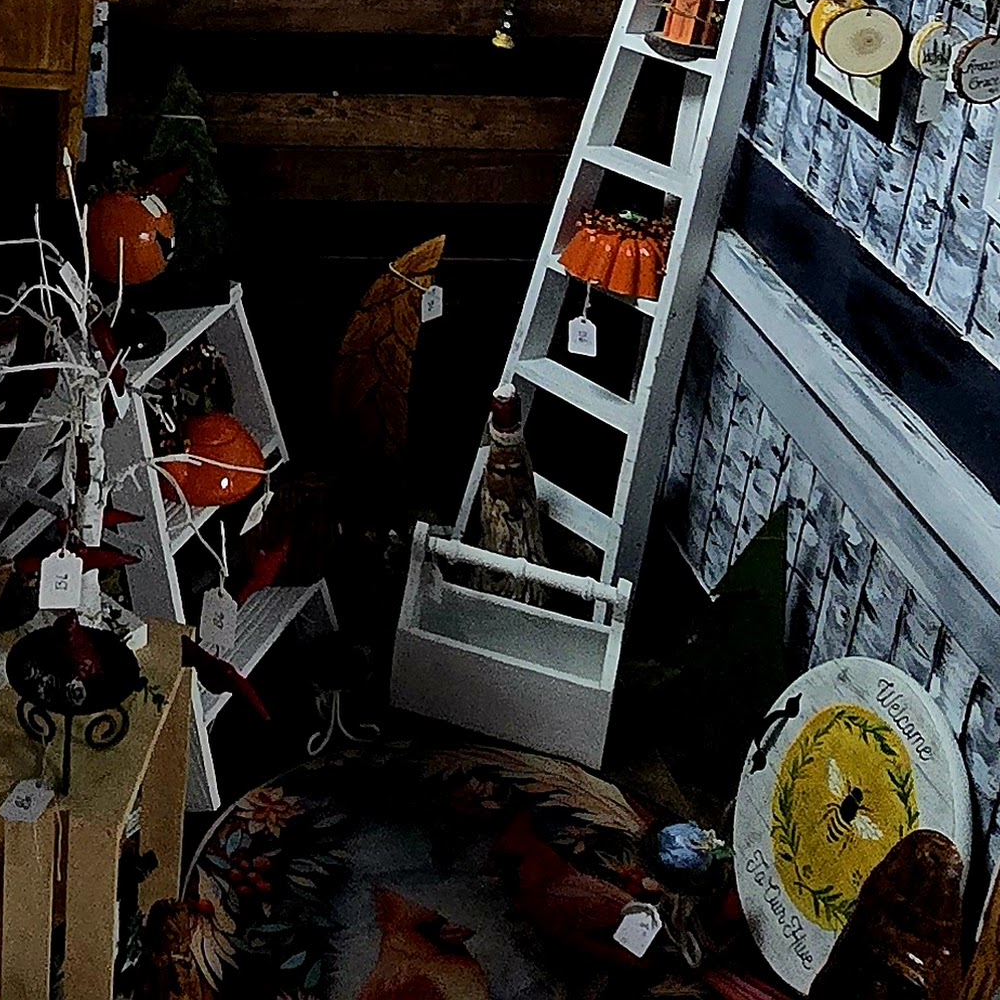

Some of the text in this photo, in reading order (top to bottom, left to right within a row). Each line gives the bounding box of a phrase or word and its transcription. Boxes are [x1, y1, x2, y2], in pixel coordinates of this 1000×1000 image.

[876, 677, 934, 763] Welcome
[745, 849, 814, 971] To Our Hive
